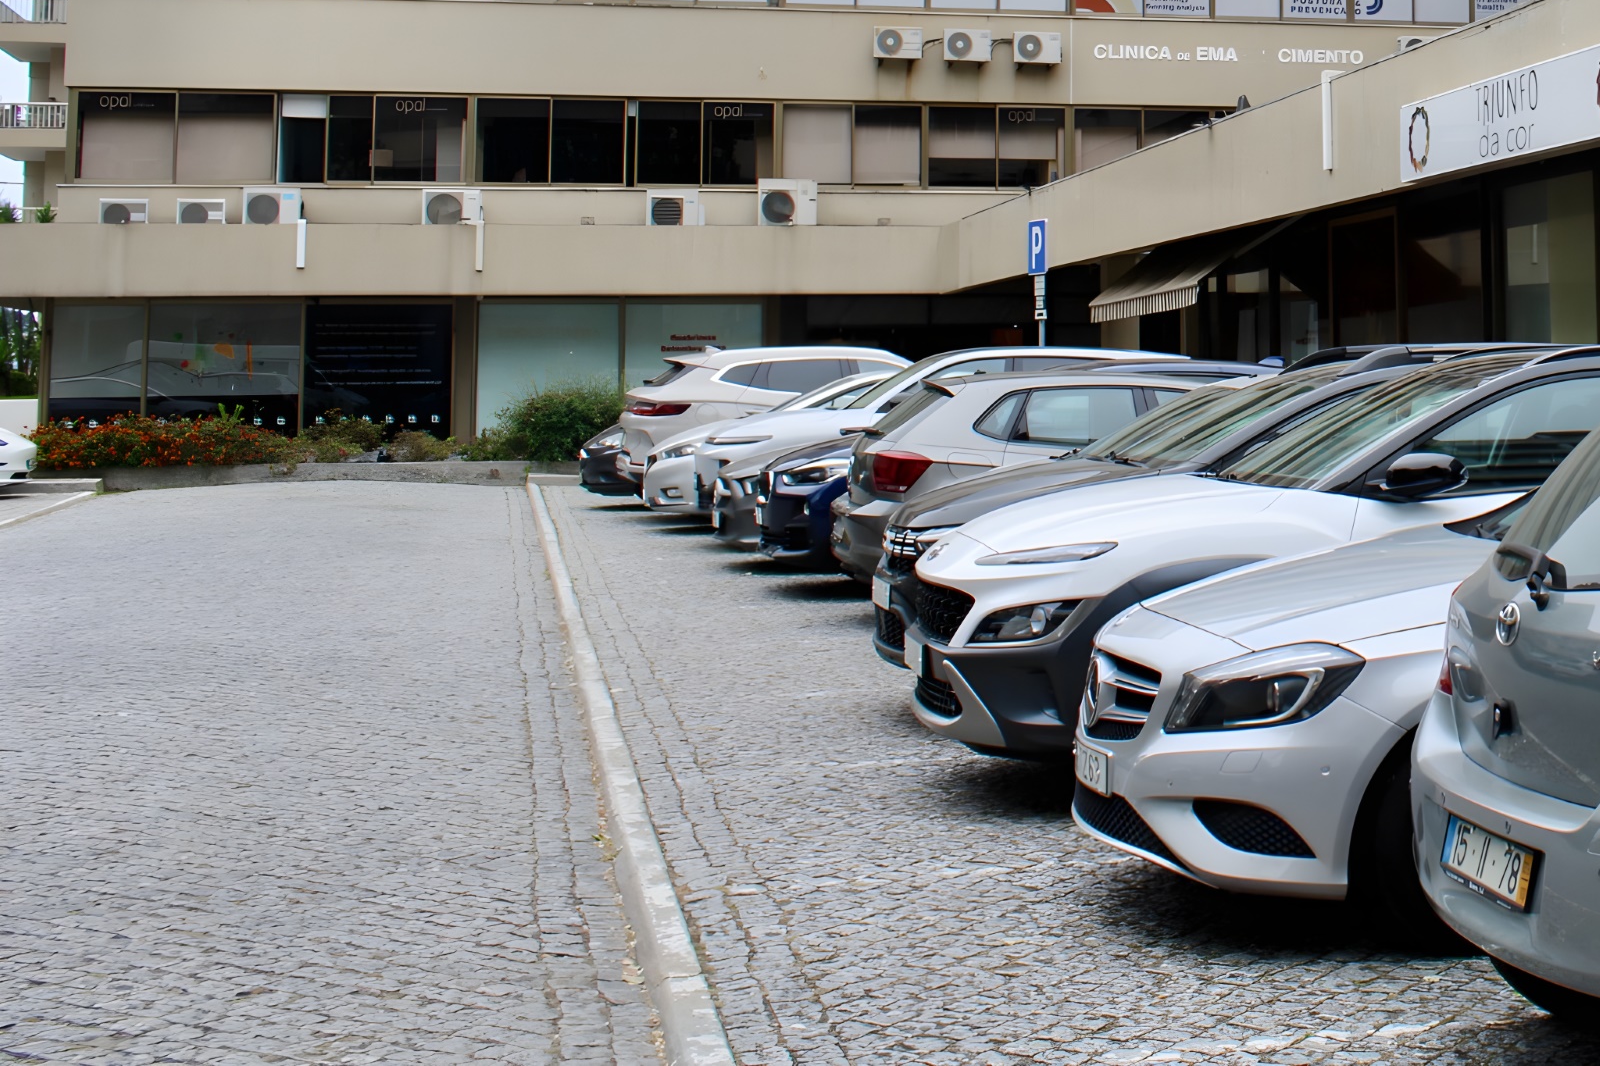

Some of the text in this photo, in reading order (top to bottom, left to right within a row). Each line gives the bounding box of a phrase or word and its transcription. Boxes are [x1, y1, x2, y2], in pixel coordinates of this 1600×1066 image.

[1093, 43, 1173, 61] CLINICA
[1196, 46, 1239, 63] EMA
[1277, 47, 1365, 66] CIMENTO
[99, 92, 132, 110] opal
[395, 97, 426, 115] opal
[1475, 69, 1538, 126] TRIUNFO
[714, 103, 743, 120] opal
[1479, 123, 1535, 158] da cor
[1032, 226, 1042, 269] P
